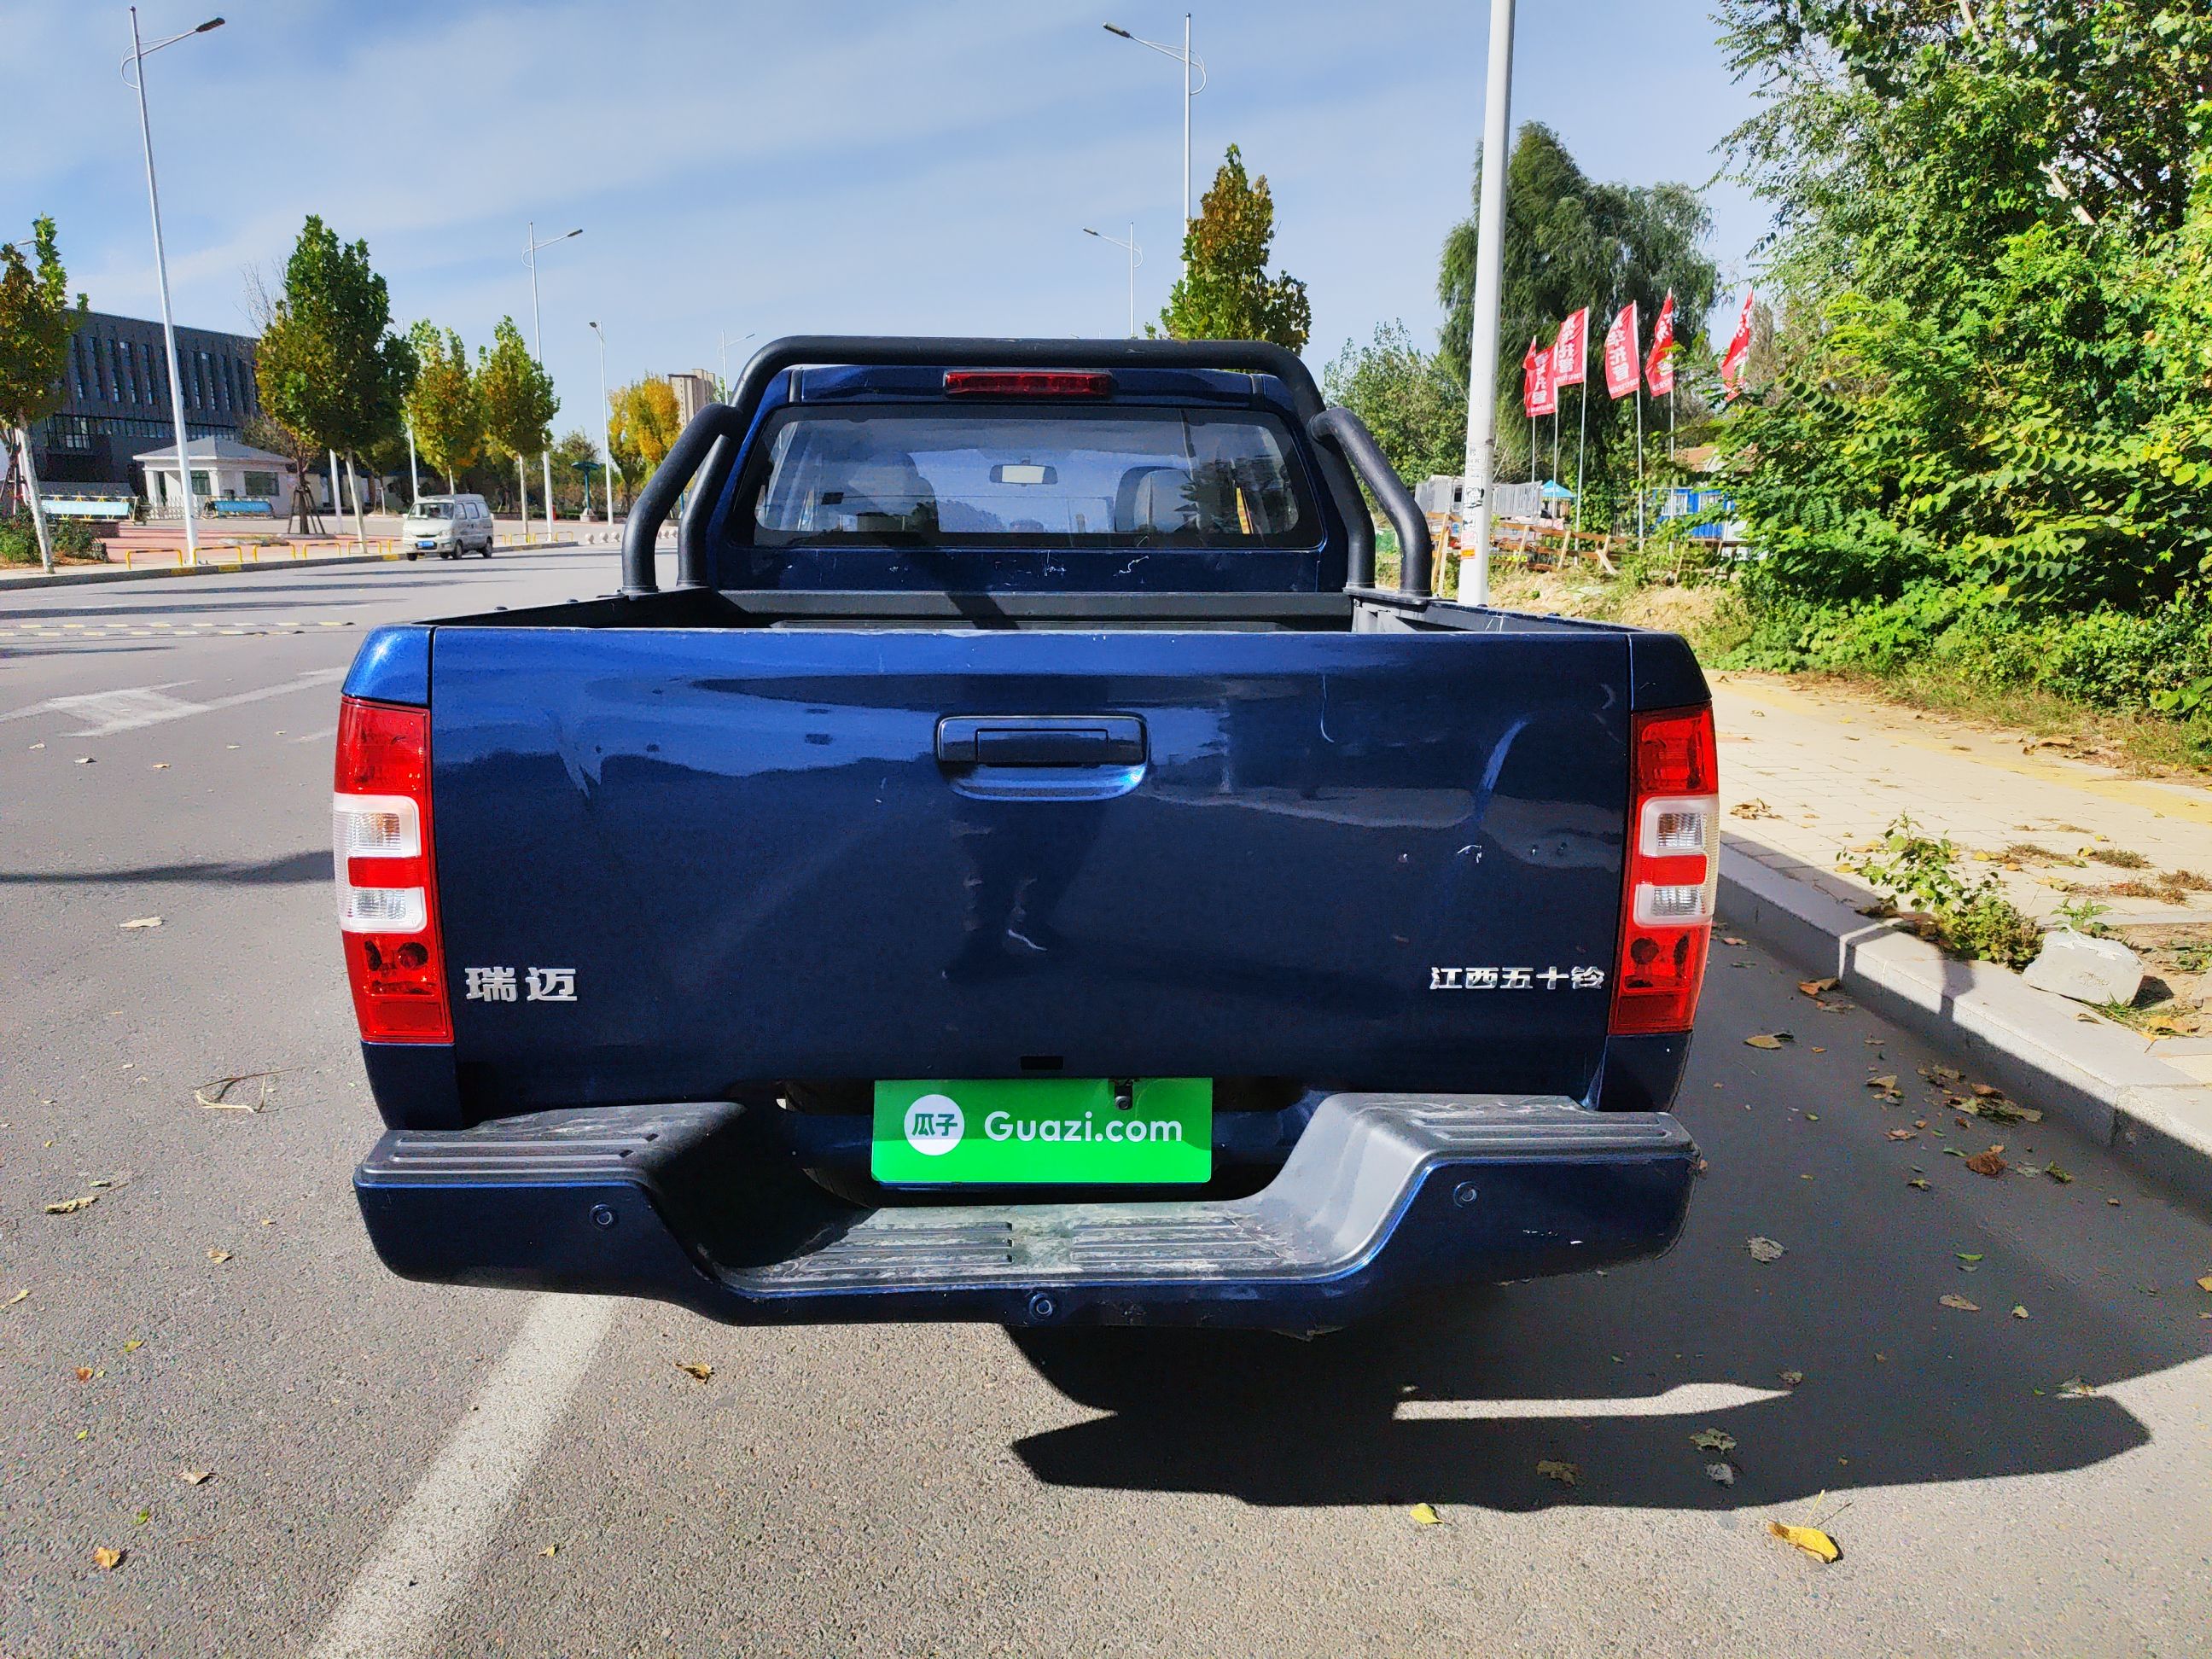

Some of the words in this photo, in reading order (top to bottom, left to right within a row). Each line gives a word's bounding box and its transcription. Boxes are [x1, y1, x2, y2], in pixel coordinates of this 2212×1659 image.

[464, 966, 578, 1002] 瑞迈
[1429, 966, 1605, 990] 江西五十铃
[911, 1113, 958, 1137] 瓜子
[984, 1110, 1183, 1142] Guazi.com
